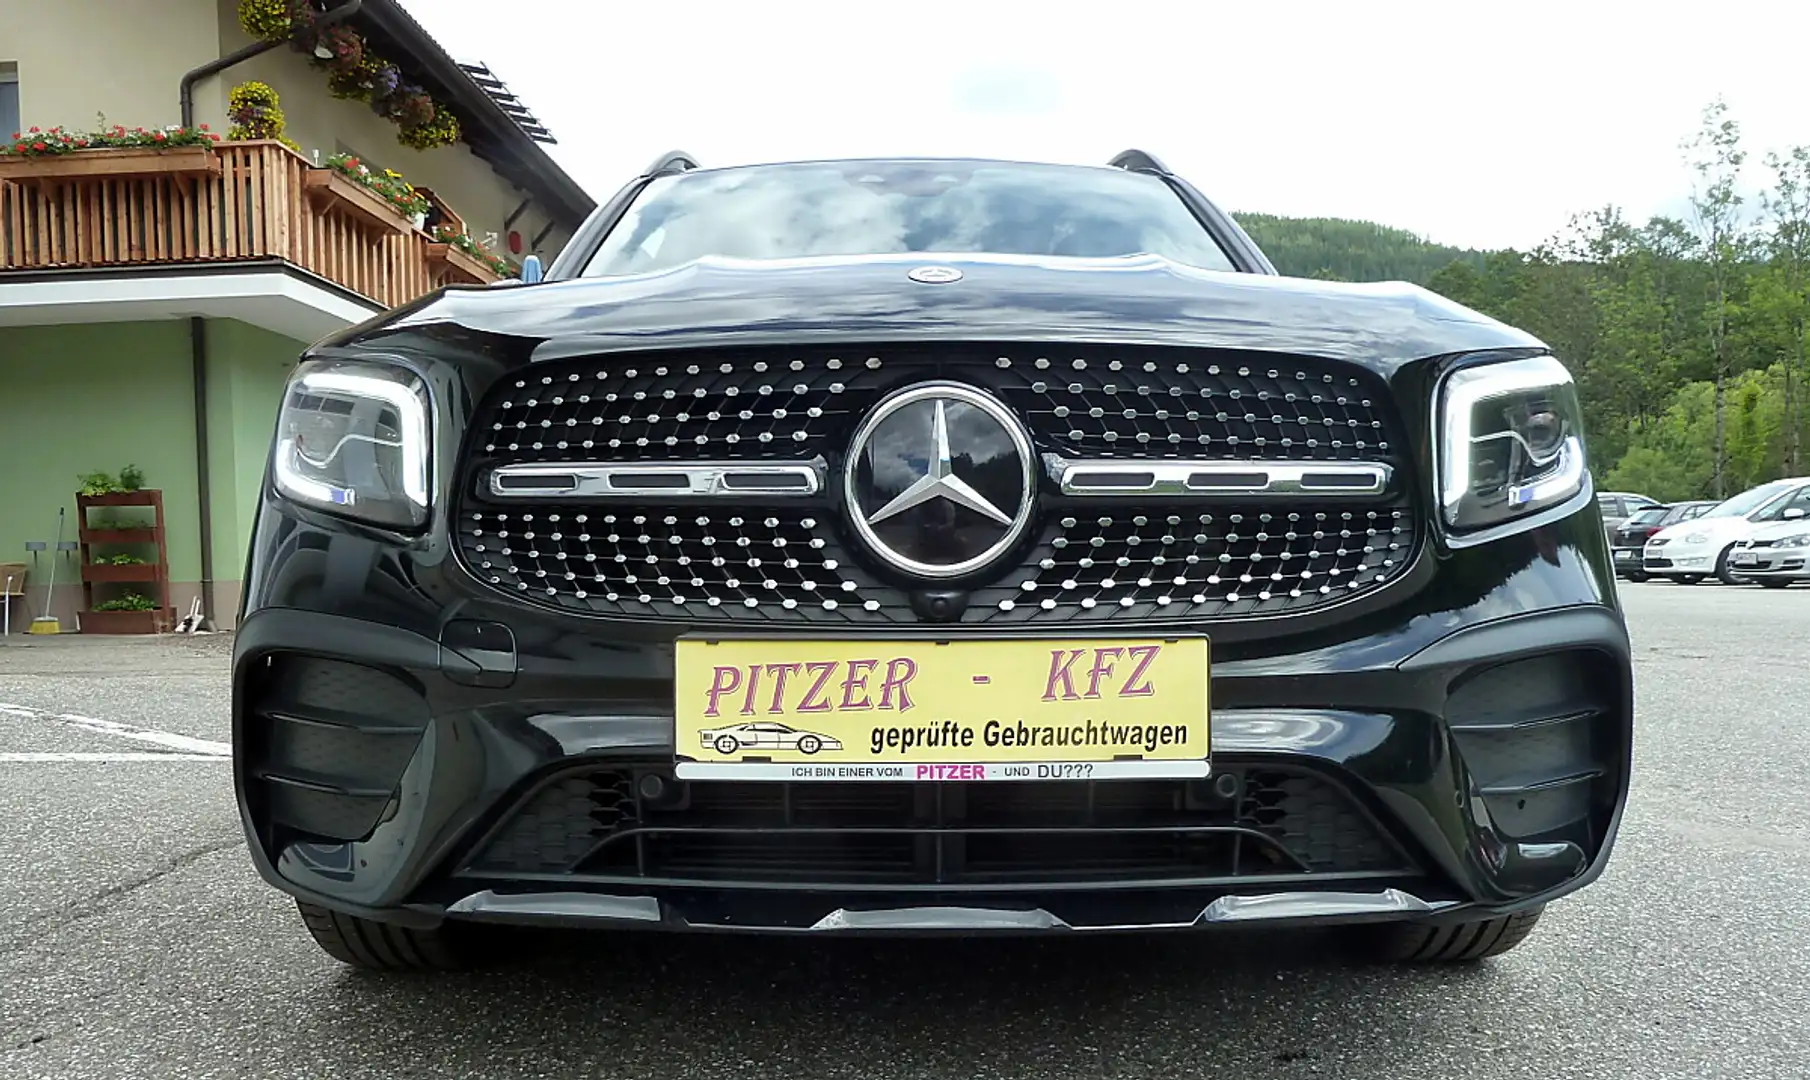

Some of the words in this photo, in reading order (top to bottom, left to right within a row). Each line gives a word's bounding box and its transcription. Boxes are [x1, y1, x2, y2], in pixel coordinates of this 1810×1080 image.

[704, 657, 918, 717] PITZER
[1041, 645, 1161, 702] KFZ
[870, 720, 974, 754] geprüfte
[983, 720, 1188, 752] Gebrauchtwagen
[791, 767, 813, 777] ICH
[815, 767, 836, 777] BIN
[838, 767, 874, 777] EINER
[876, 767, 903, 777] VOM
[916, 764, 985, 779] PITZER
[1004, 766, 1030, 777] UND
[1037, 764, 1093, 778] DU???
